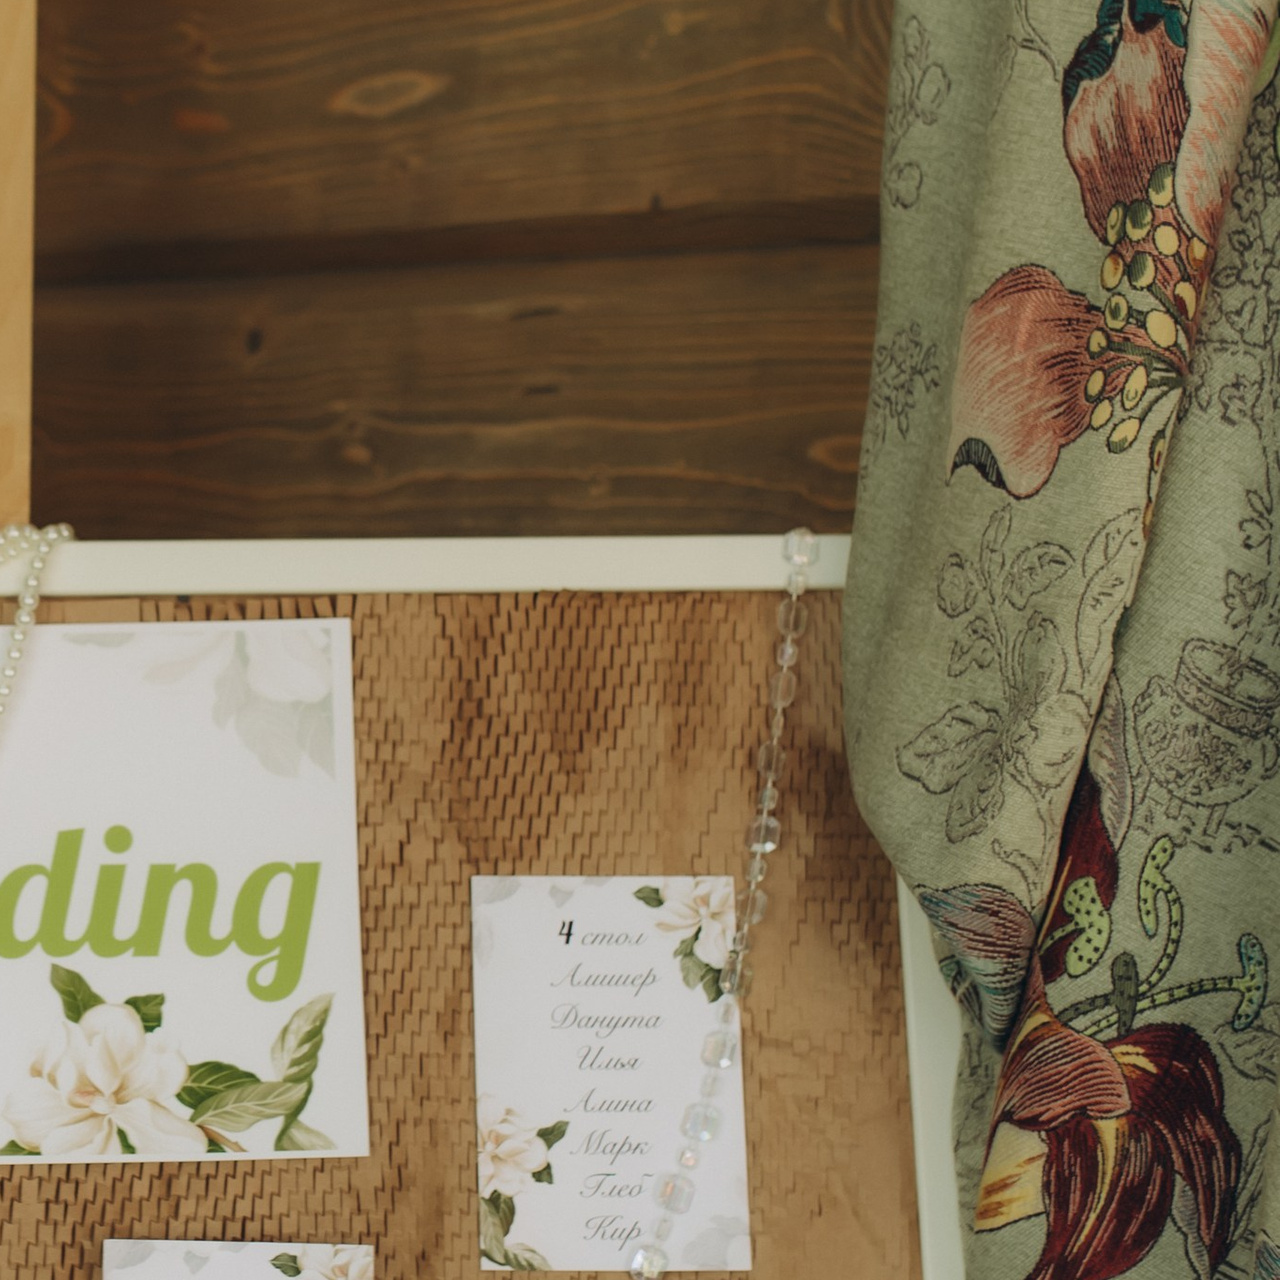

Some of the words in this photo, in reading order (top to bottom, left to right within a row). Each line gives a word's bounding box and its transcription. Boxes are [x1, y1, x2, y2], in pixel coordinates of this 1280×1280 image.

[557, 919, 575, 946] 4
[580, 932, 646, 946] стол
[550, 962, 658, 996] Алишер
[551, 1004, 661, 1039] Данута
[578, 1045, 641, 1071] Илья
[563, 1088, 653, 1113] Алина
[570, 1129, 649, 1165] Марк
[583, 1215, 647, 1251] Кир
